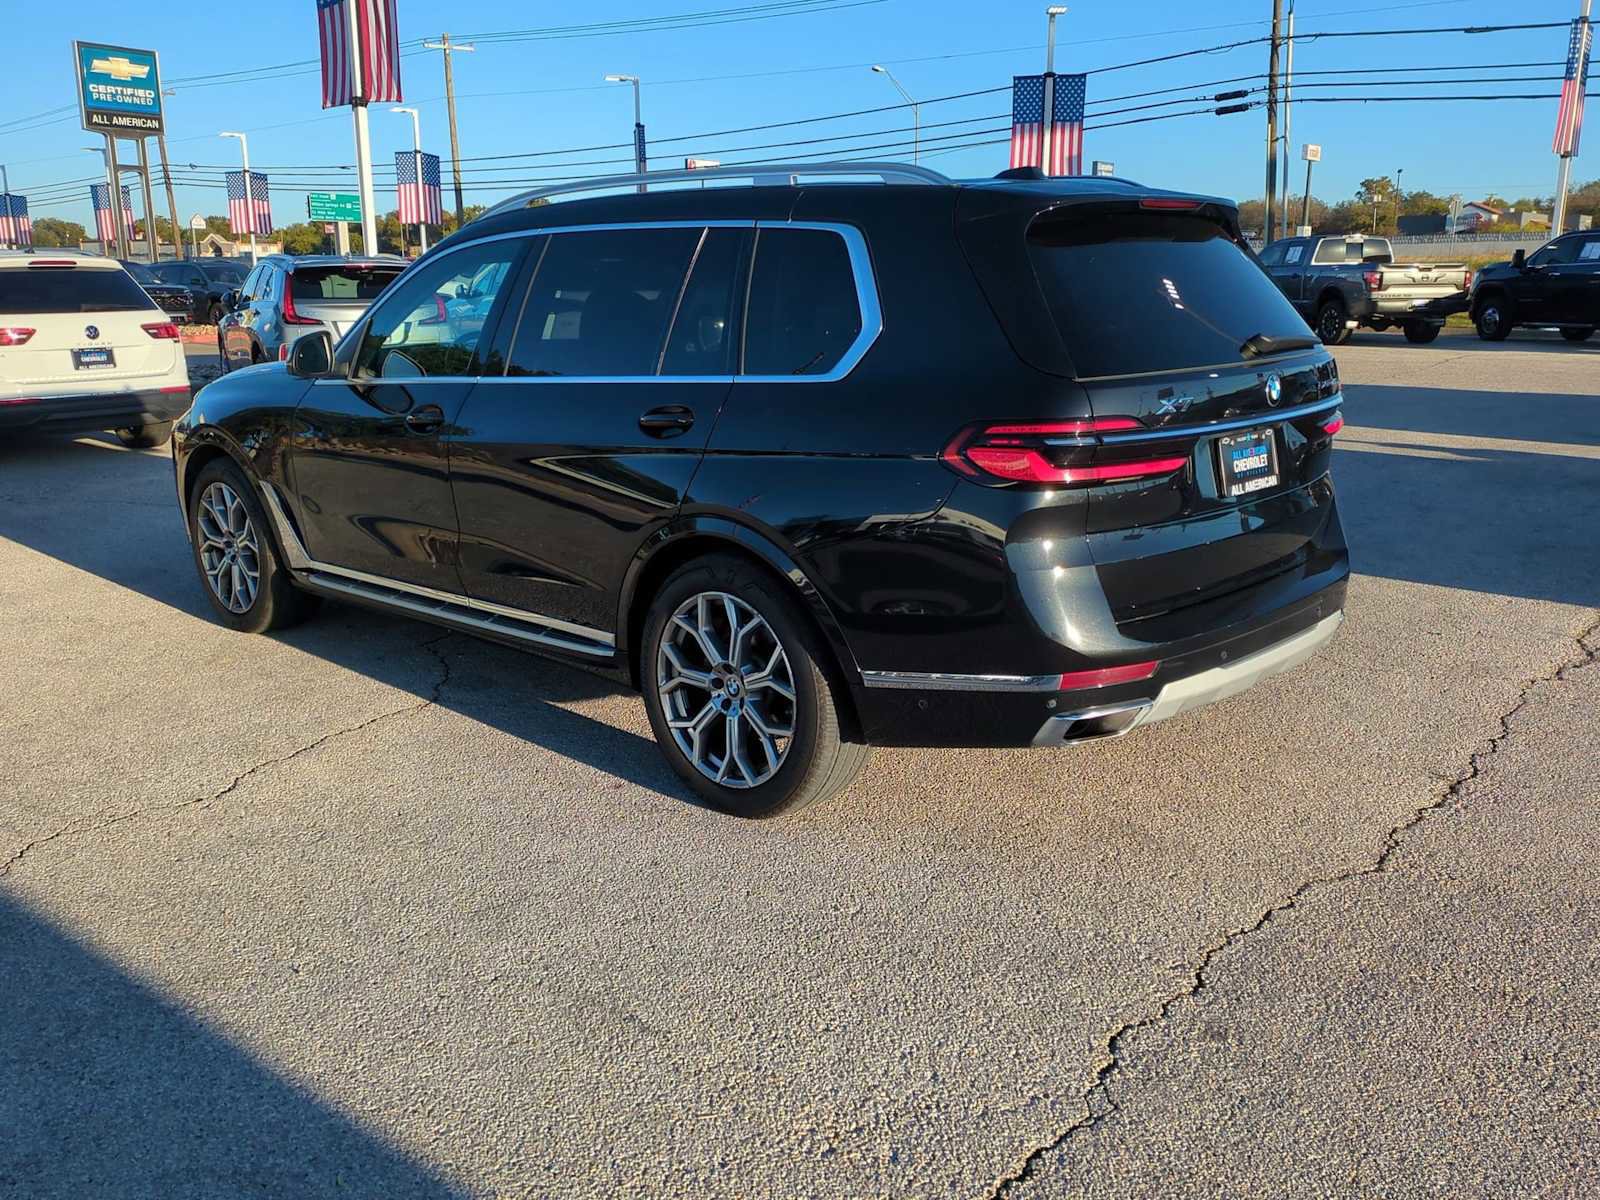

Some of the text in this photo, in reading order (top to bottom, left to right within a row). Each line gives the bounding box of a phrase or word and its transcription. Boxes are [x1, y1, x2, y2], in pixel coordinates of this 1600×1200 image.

[89, 84, 155, 98] CERTIFIED
[92, 93, 154, 106] PRE-OWNED
[92, 114, 159, 128] ALL AMERICAN
[1233, 454, 1268, 472] CHEVROLET
[1231, 475, 1277, 496] ALL AMERICAN
